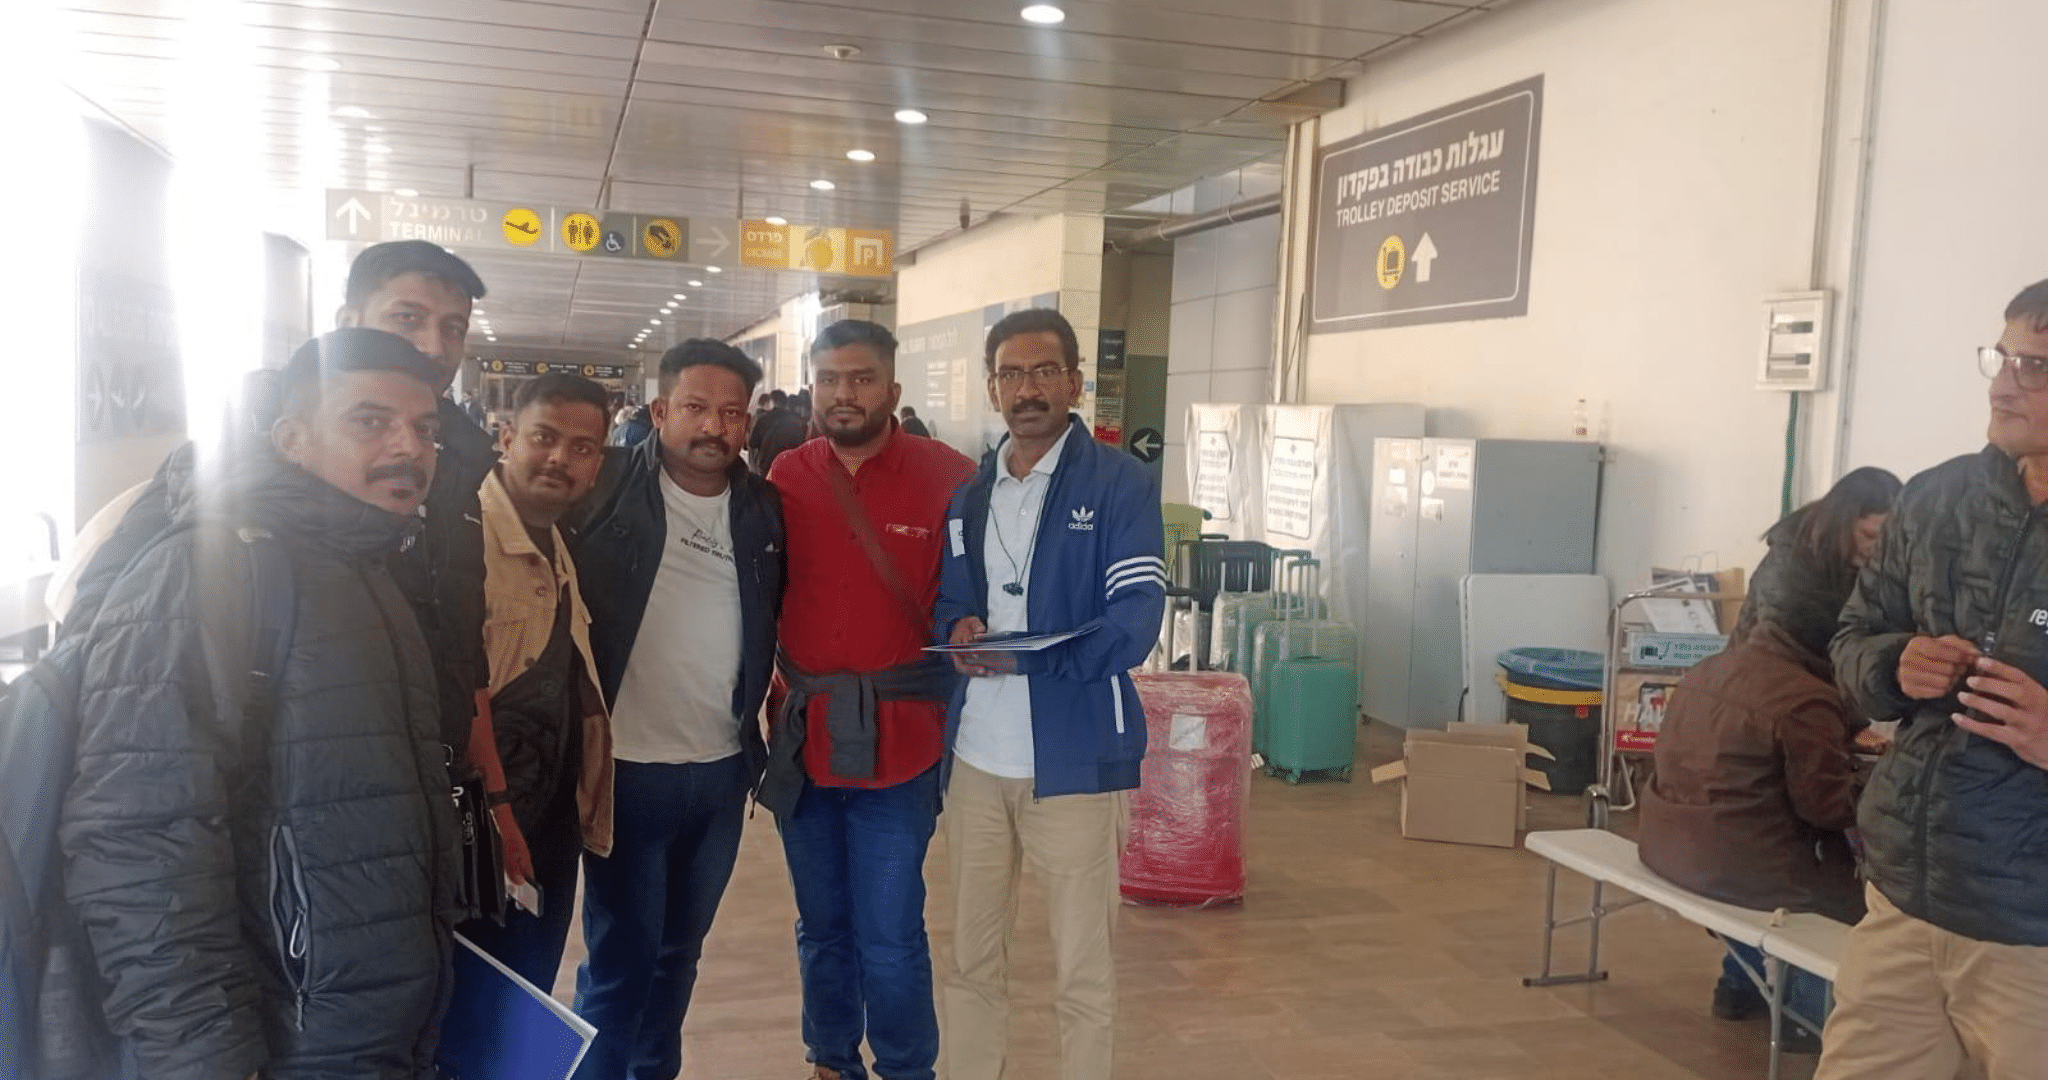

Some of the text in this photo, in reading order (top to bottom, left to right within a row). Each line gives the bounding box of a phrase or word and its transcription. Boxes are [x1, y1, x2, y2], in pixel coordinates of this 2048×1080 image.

[1336, 128, 1505, 206] עגלות כבודה בפקדון
[389, 197, 488, 222] טרמינל
[1336, 170, 1501, 228] TROLLEY DEPOSIT SERVICE
[389, 221, 484, 243] TERMINAL
